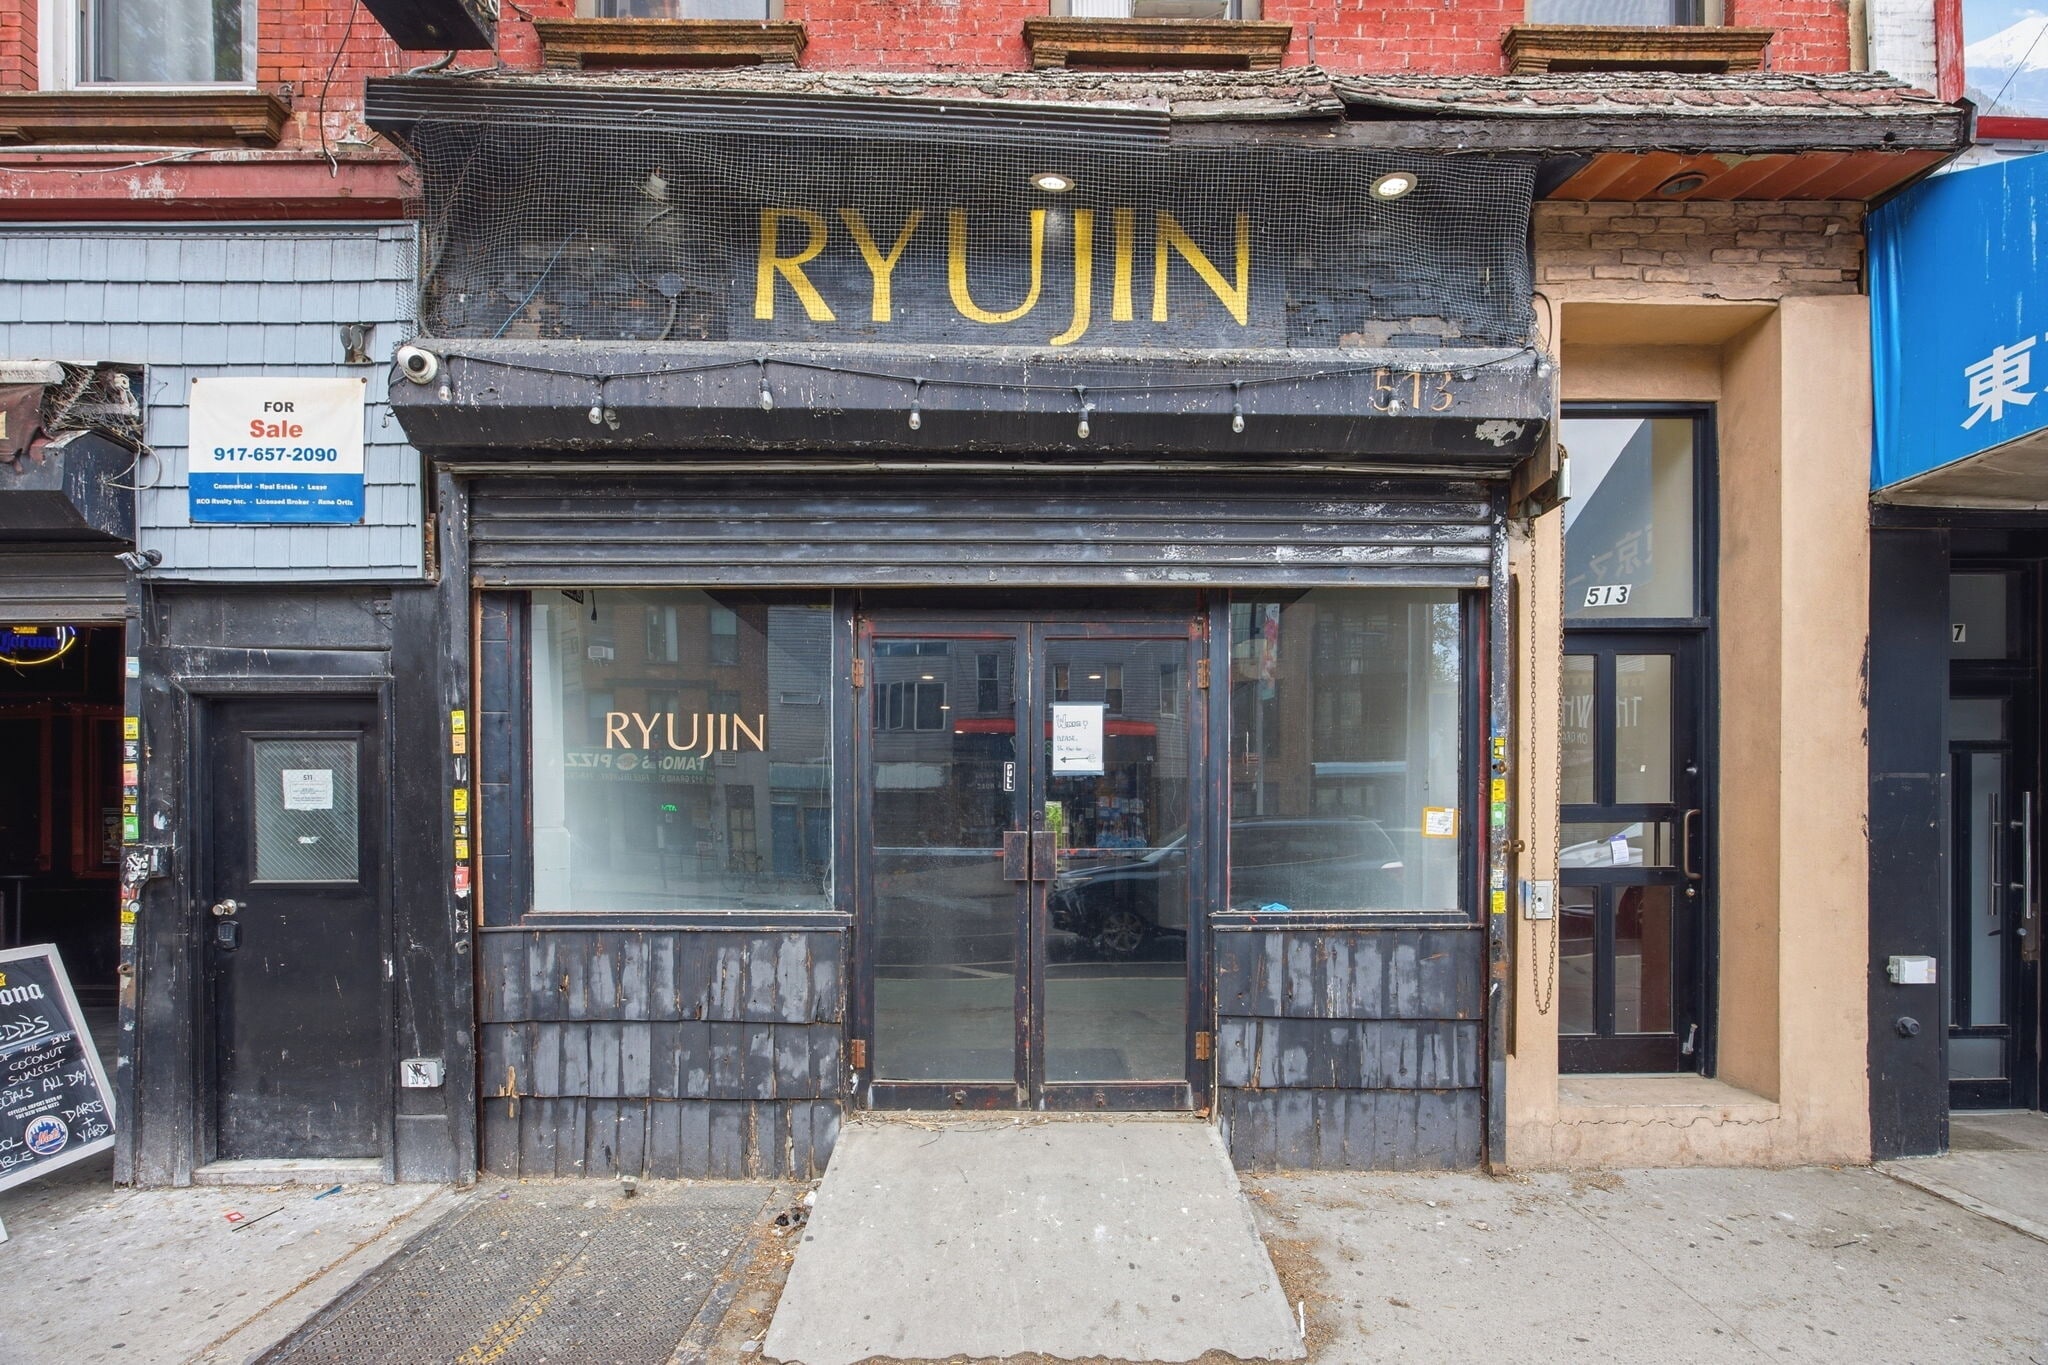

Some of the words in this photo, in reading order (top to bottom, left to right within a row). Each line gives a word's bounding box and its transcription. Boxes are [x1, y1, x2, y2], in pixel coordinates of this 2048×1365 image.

[754, 207, 1250, 346] RYUJIN
[1369, 368, 1454, 411] 513
[1960, 332, 2048, 430] 東
[264, 401, 295, 413] FOR
[250, 419, 303, 438] Sale
[214, 447, 337, 462] 917-657-2090
[213, 482, 253, 490] Commercial
[1587, 586, 1628, 605] 513
[1954, 624, 1964, 641] 7
[605, 712, 765, 759] RYUJIN
[19, 1042, 42, 1053] THE
[9, 1045, 67, 1071] COCONUT
[8, 1059, 67, 1087] SUNSET
[43, 1075, 64, 1092] ALL
[61, 1100, 104, 1123] DARTS
[76, 1124, 108, 1142] YARD
